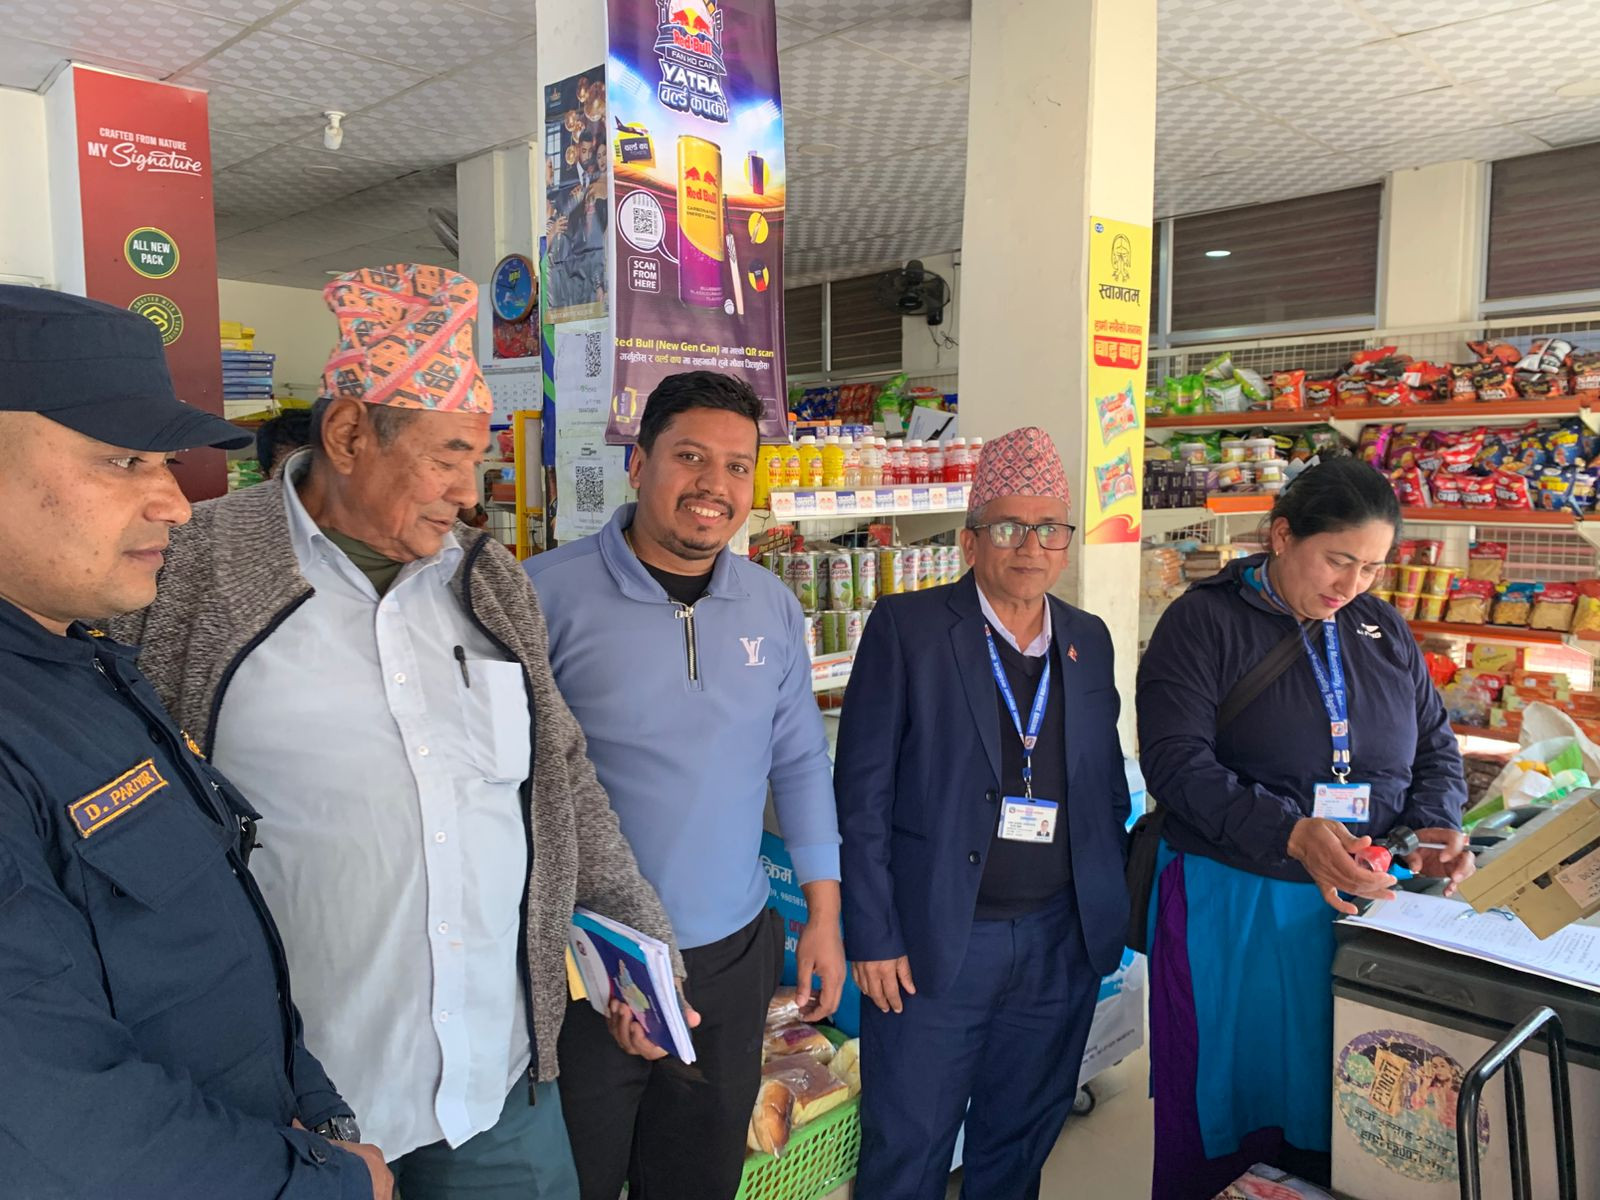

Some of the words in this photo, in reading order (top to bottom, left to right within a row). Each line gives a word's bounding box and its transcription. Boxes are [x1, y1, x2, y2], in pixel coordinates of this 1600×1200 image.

[673, 29, 692, 50] Red
[692, 36, 713, 57] Bull
[671, 50, 687, 61] FAN
[698, 60, 715, 71] CAN
[663, 62, 721, 95] YATRA
[99, 127, 135, 142] CRAFTED
[135, 134, 157, 146] FROM
[158, 138, 187, 151] NATURE
[87, 141, 108, 158] MY
[109, 142, 202, 176] Signature
[686, 185, 703, 201] Red
[133, 239, 149, 251] ALL
[150, 241, 171, 254] NEW
[141, 252, 164, 266] PACK
[633, 260, 656, 271] SCAN
[633, 269, 657, 280] FROM
[634, 278, 656, 289] HERE
[1098, 283, 1141, 306] स्वागतम्
[614, 337, 633, 347] Red
[636, 338, 654, 349] Bull
[656, 340, 679, 351] (New
[680, 342, 698, 352] Gen
[700, 343, 720, 356] Can)
[745, 347, 757, 357] QR
[758, 349, 774, 358] scan
[84, 803, 110, 821] D.
